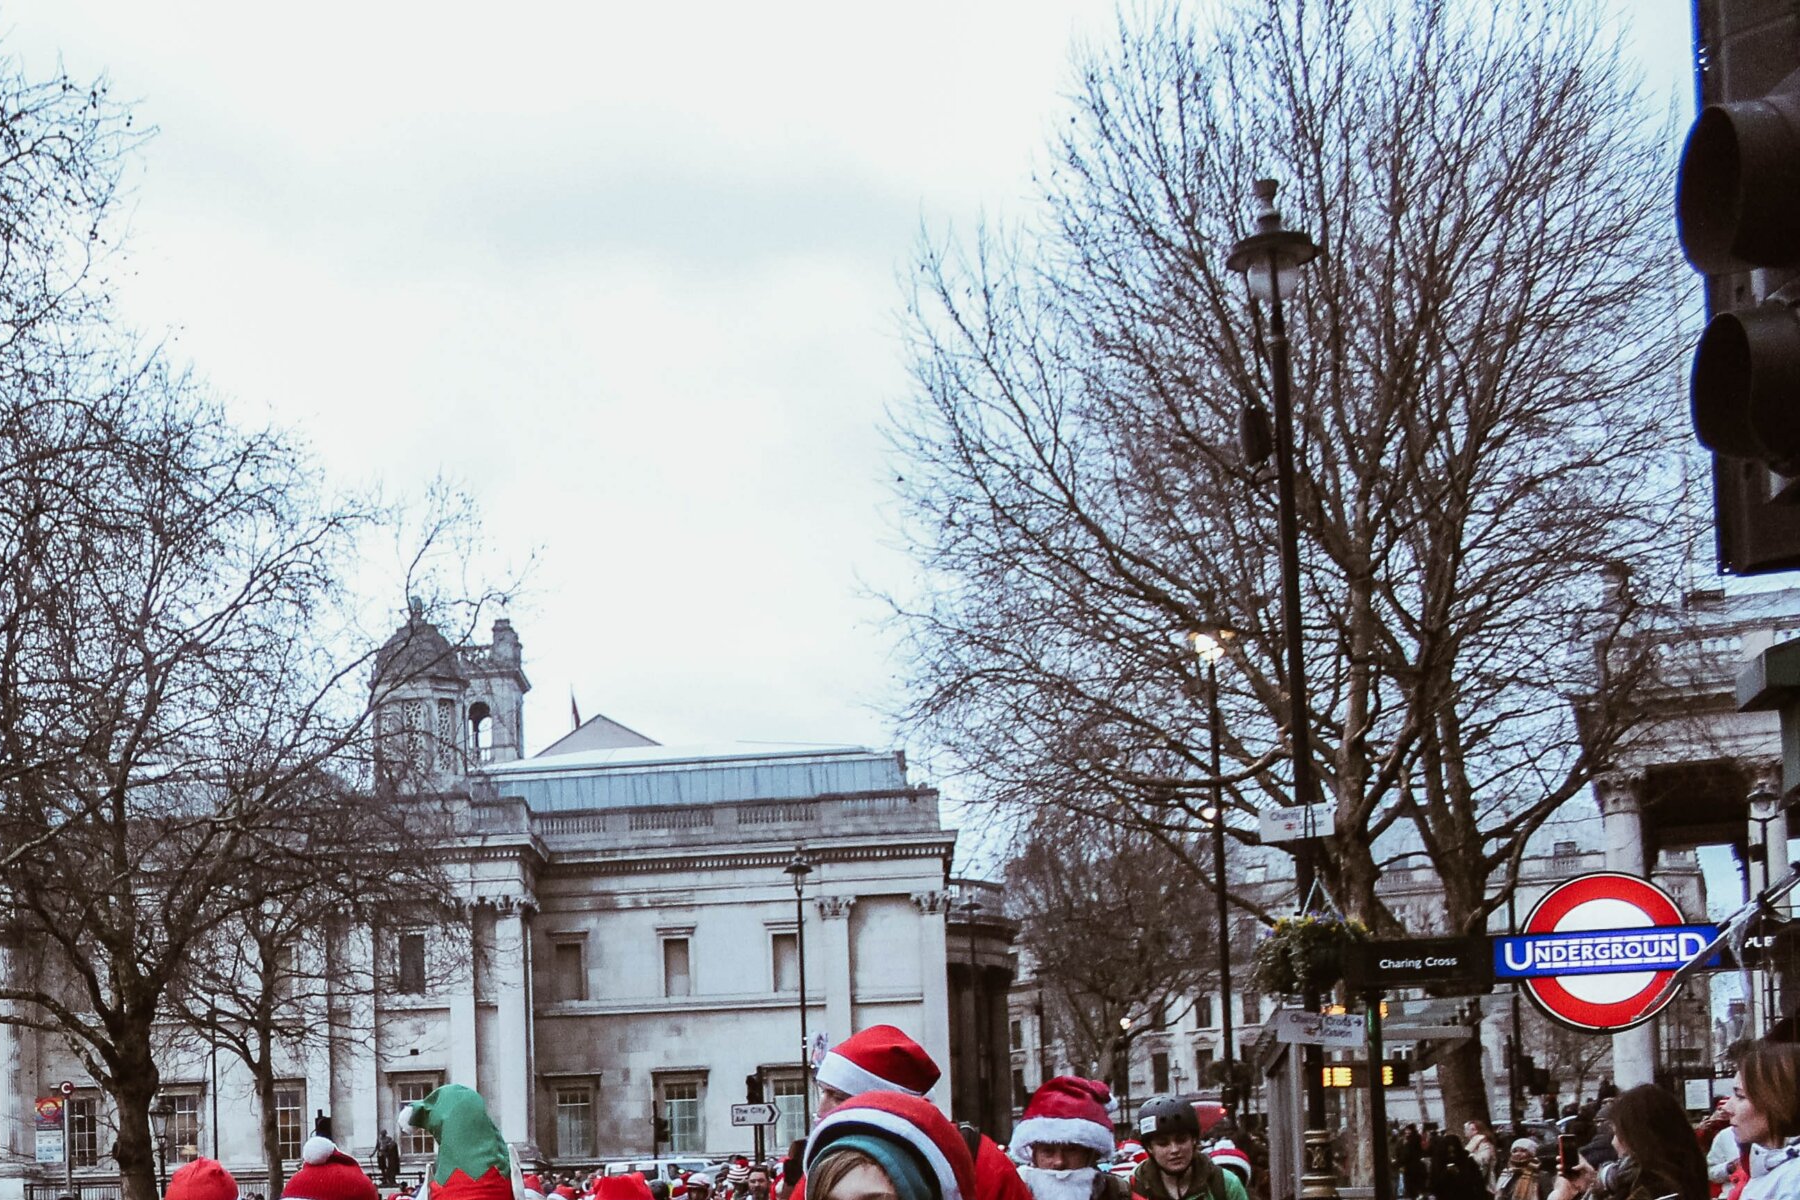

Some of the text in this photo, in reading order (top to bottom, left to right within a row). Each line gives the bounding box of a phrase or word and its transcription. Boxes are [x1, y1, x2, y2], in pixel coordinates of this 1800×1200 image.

[1504, 932, 1707, 971] UNDERGROUND
[1379, 956, 1457, 969] Charing Cross
[61, 1082, 71, 1094] C
